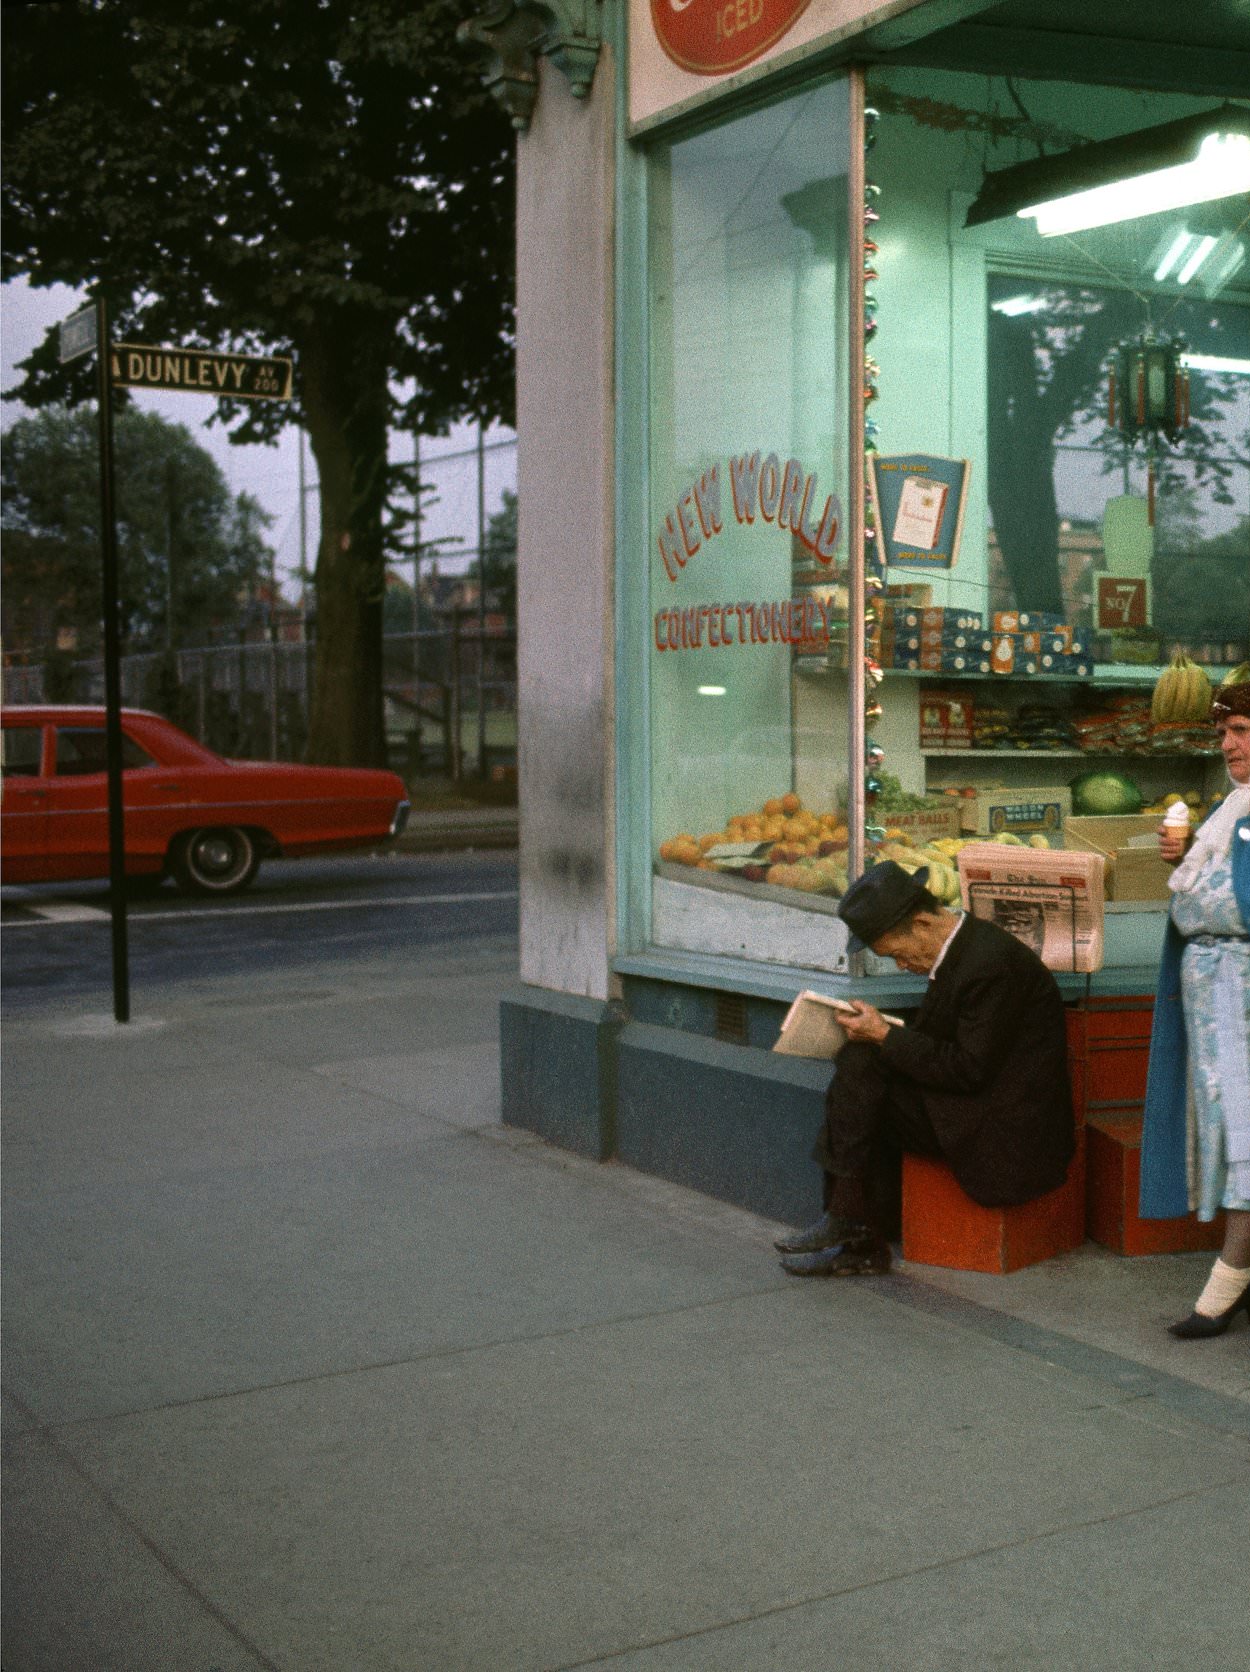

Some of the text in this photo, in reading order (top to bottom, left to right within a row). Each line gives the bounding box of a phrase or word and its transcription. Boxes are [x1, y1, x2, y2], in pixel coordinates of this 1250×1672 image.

[716, 0, 763, 44] ICED
[128, 352, 246, 389] DUNLEVY
[658, 447, 843, 582] NEW WORLD
[654, 596, 835, 652] CONFECTIONERY
[1115, 585, 1138, 622] 7
